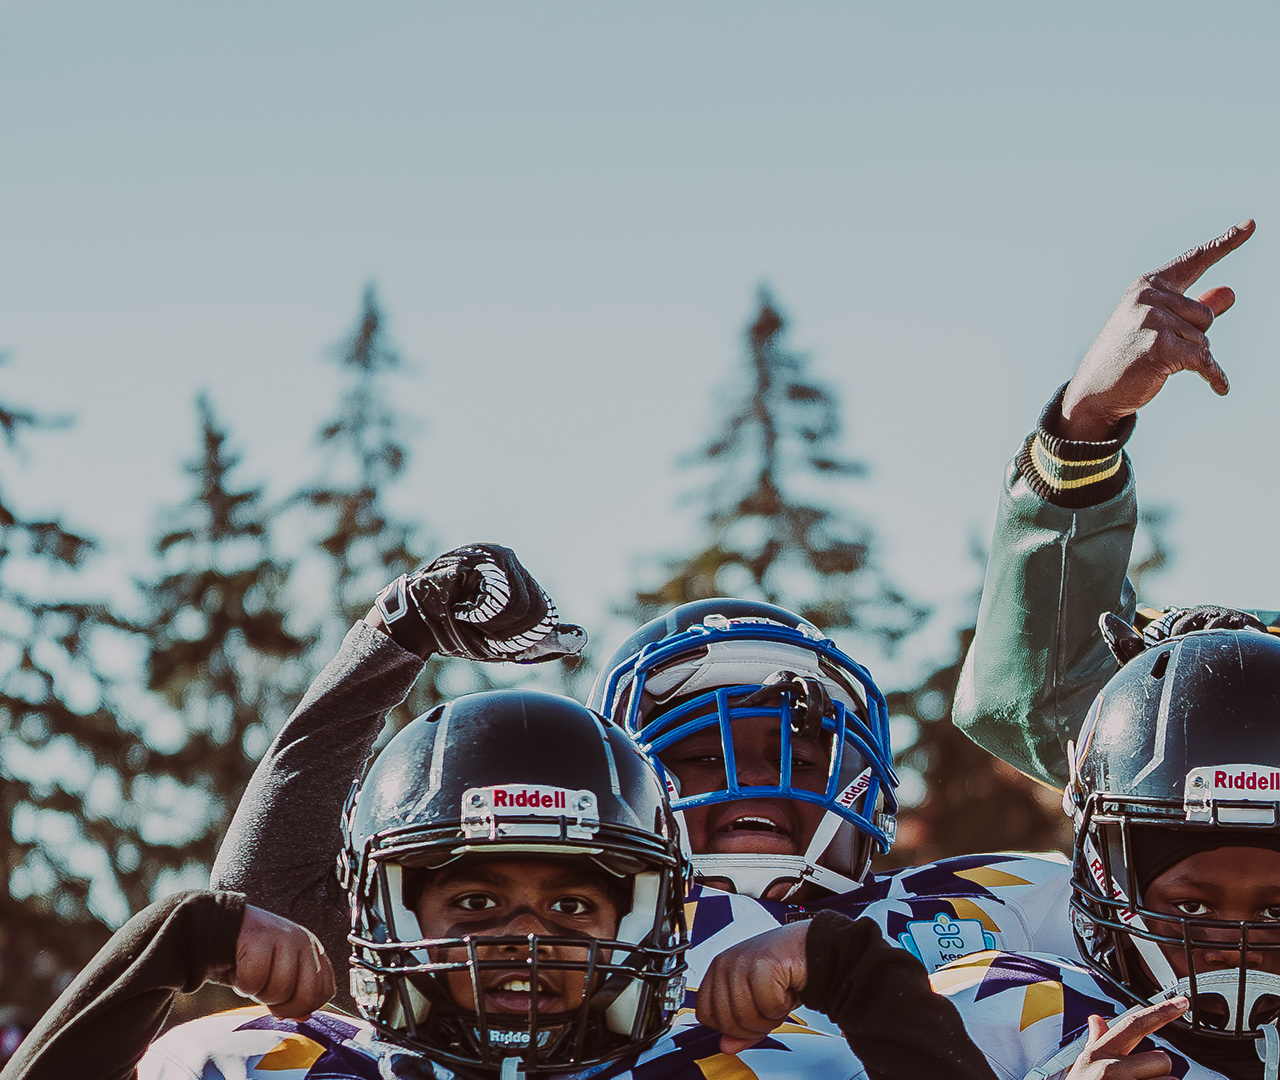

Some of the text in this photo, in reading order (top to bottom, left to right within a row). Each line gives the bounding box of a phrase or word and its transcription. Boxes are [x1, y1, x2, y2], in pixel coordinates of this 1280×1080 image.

[840, 774, 870, 805] iddell
[1214, 770, 1280, 790] Riddell
[493, 789, 564, 808] Riddell
